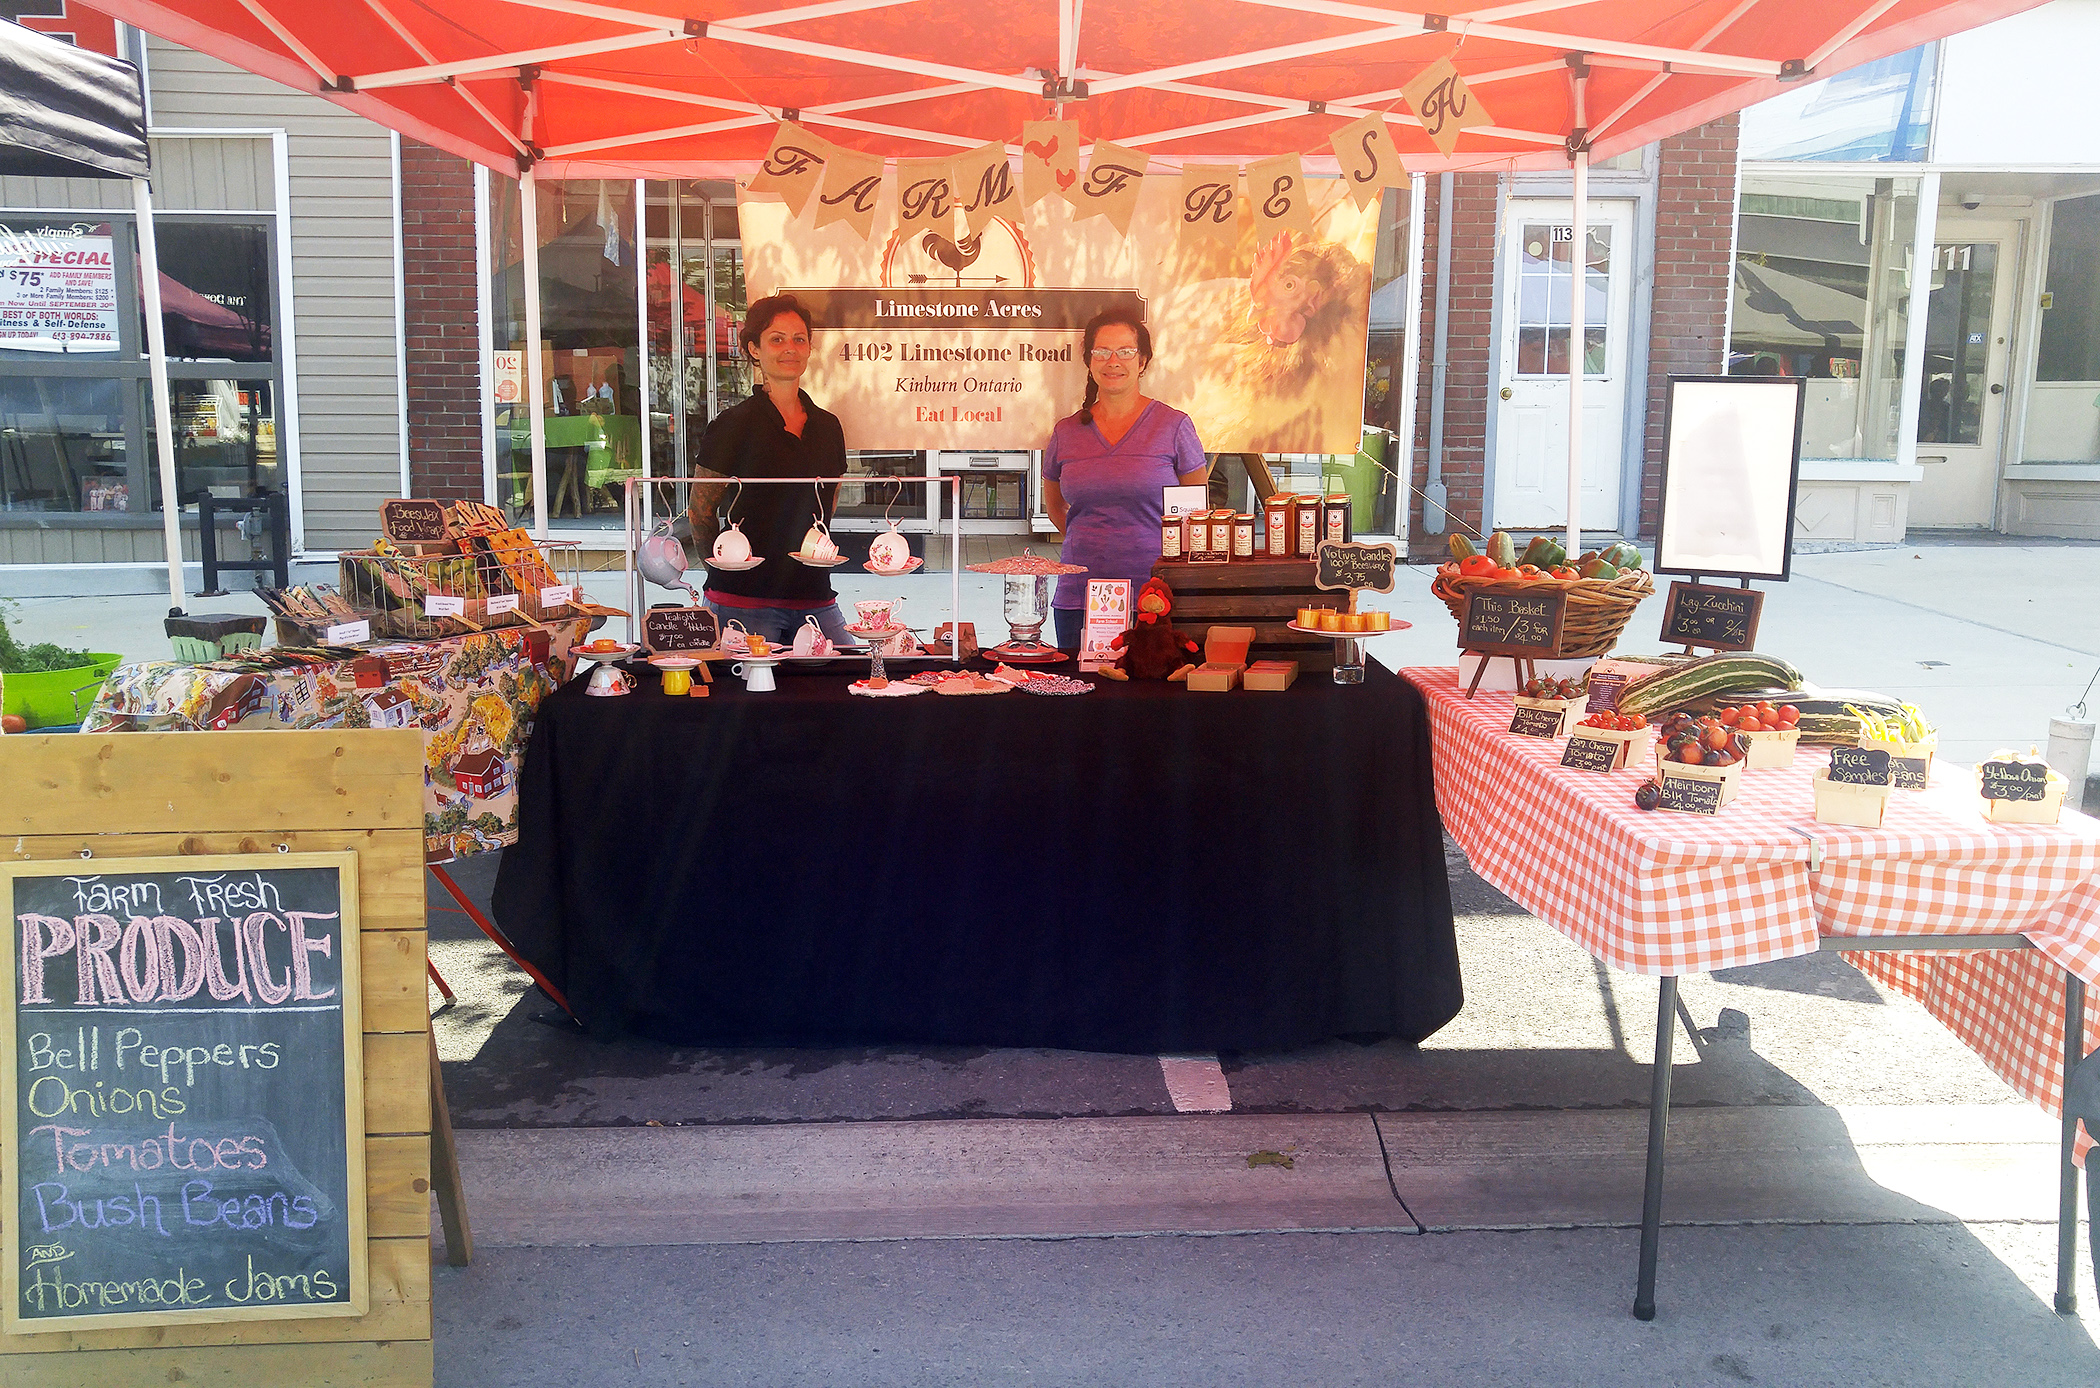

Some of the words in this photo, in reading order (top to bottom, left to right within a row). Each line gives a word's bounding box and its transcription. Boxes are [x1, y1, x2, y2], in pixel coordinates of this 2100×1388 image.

[1553, 227, 1573, 241] 113
[83, 272, 112, 280] MEMBERS
[3, 310, 23, 319] BEST
[26, 310, 36, 319] OF
[39, 311, 60, 320] BOTH
[875, 299, 979, 318] Limestone
[984, 299, 1042, 318] Acres
[0, 318, 28, 327] itness
[33, 319, 39, 327] &
[839, 342, 893, 362] 4402
[900, 342, 1012, 362] Limestone
[1018, 342, 1073, 362] Road
[894, 376, 958, 393] Kinburn
[963, 376, 1023, 393] Ontario
[915, 406, 945, 423] Eat
[951, 406, 1003, 423] Local
[391, 503, 440, 522] Beeswax
[390, 520, 415, 535] Food
[1324, 547, 1357, 560] Votive
[1359, 549, 1392, 562] Candles
[1350, 561, 1386, 572] Beeswax
[1475, 596, 1503, 612] This
[1508, 600, 1547, 616] Basket
[1703, 594, 1744, 613] Zucchini
[649, 621, 679, 631] Candle
[1471, 624, 1489, 633] each
[1518, 620, 1530, 634] 3
[1517, 708, 1533, 721] Blk
[1535, 711, 1560, 726] Cherry
[1520, 719, 1548, 729] Tomato
[1568, 748, 1606, 762] Tomato
[1588, 740, 1616, 756] Cherry
[1833, 767, 1887, 785] Samples
[1892, 770, 1925, 783] eans
[1984, 765, 2019, 780] Yellow
[2020, 767, 2047, 784] Onion
[1665, 778, 1718, 796] Heirloom
[1661, 789, 1683, 802] Blk
[1687, 791, 1719, 806] Tomato
[17, 911, 340, 1006] PRODUCE
[28, 1026, 98, 1073] Bell
[115, 1027, 281, 1087] Peppers
[29, 1075, 187, 1119] Onions
[30, 1121, 268, 1174] Tomatoes
[32, 1180, 170, 1236] Bush
[181, 1179, 318, 1231] Beans
[31, 1245, 67, 1260] AND
[25, 1265, 211, 1311] Homemade
[225, 1253, 338, 1302] Jams
